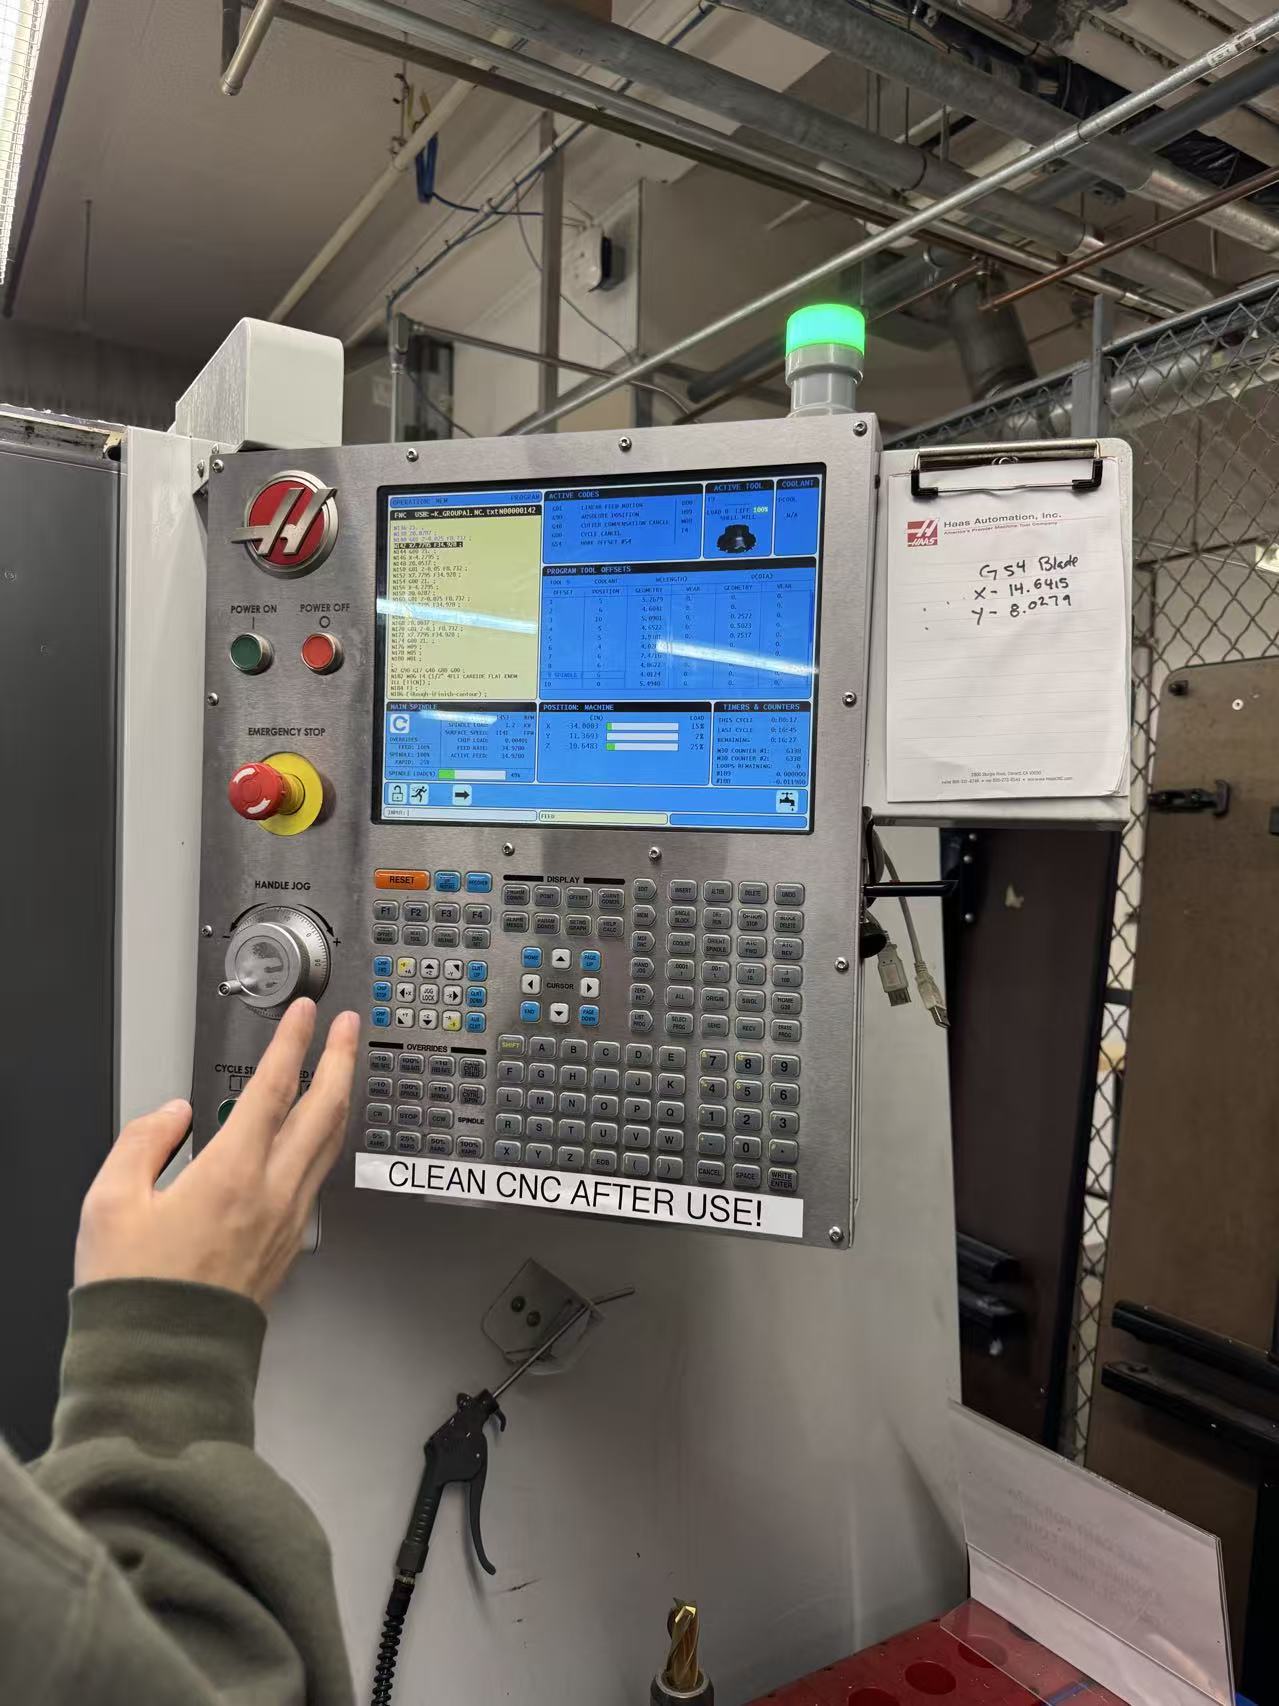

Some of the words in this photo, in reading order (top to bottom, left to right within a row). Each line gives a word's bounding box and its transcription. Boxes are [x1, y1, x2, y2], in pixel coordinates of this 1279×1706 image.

[714, 484, 739, 492] ACTIVE
[974, 514, 1038, 525] Automation,
[1039, 555, 1078, 572] Blade
[1009, 577, 1069, 596] 14.6415
[231, 605, 260, 613] POWER
[264, 605, 277, 613] ON
[300, 604, 331, 612] POWER
[333, 603, 350, 612] OFF
[1010, 594, 1072, 618] 8.0279
[248, 728, 301, 736] EMERGENCY
[304, 728, 325, 736] STOP
[390, 876, 414, 884] RESET
[547, 875, 580, 883] DISPLAY
[255, 880, 289, 890] HANDLE
[291, 882, 311, 891] JOG
[411, 908, 421, 916] F2
[441, 909, 451, 917] F3
[472, 911, 482, 919] F4
[546, 982, 574, 990] CURSOR
[407, 1044, 447, 1052] OVERRIDES
[538, 1043, 545, 1051] A
[603, 1048, 609, 1056] C
[668, 1053, 674, 1061] E
[710, 1056, 716, 1066] 7
[745, 1058, 751, 1069] 8
[781, 1061, 788, 1072] 9
[215, 1064, 242, 1073] CYCLE
[538, 1070, 544, 1078] G
[569, 1073, 576, 1081] H
[635, 1078, 641, 1086] J
[667, 1081, 674, 1089] K
[709, 1084, 715, 1093] 4
[744, 1087, 750, 1096] 5
[507, 1094, 512, 1102] L
[780, 1090, 787, 1100] 6
[601, 1102, 608, 1110] O
[634, 1105, 640, 1113] P
[666, 1108, 674, 1117] Q
[709, 1112, 714, 1121] 1
[458, 1117, 484, 1125] SPINDLE
[743, 1115, 750, 1125] 2
[779, 1118, 786, 1129] 3
[568, 1126, 574, 1134] T
[600, 1129, 606, 1137] U
[664, 1136, 674, 1144] W
[504, 1147, 510, 1155] X
[743, 1142, 749, 1153] 0
[535, 1150, 541, 1158] Y
[699, 1168, 721, 1176] CANCEL
[772, 1172, 792, 1180] WRITE
[771, 1181, 792, 1189] ENTER
[388, 1161, 486, 1195] CLEAN
[496, 1171, 562, 1202] CNC
[570, 1180, 675, 1216] AFTER
[686, 1192, 763, 1227] USE!
